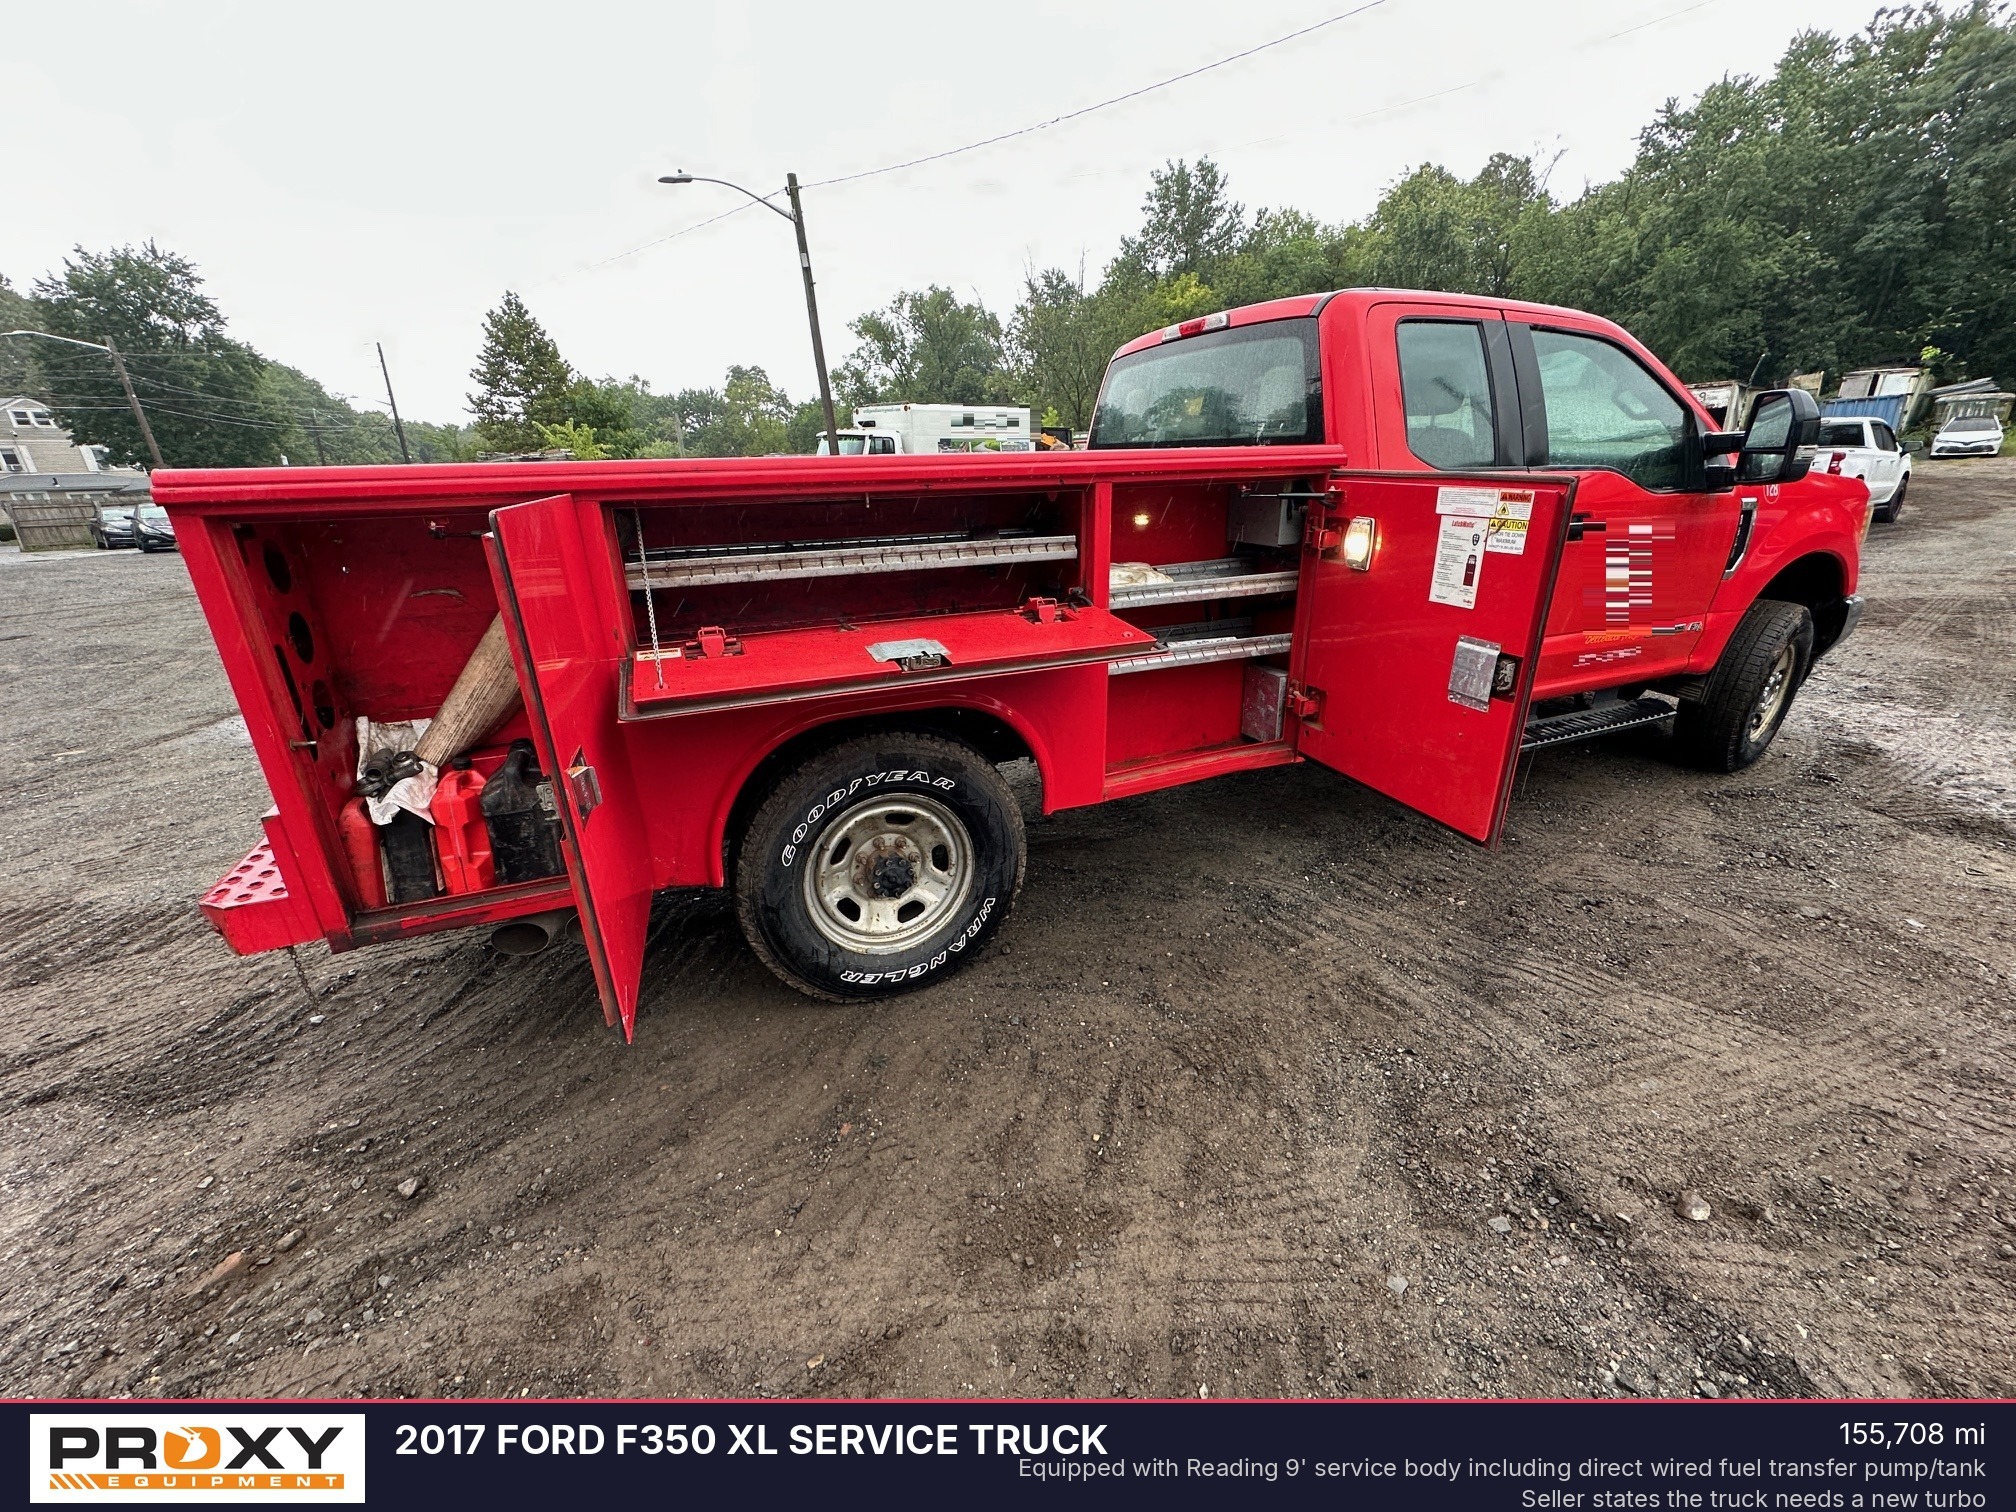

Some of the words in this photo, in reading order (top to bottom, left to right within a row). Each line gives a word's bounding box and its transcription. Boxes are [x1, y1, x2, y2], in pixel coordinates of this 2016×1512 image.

[1508, 493, 1532, 503] WARNING
[1497, 519, 1528, 530] CAUTION
[781, 770, 956, 867] GOODYEAR
[840, 897, 996, 985] WRANGLER
